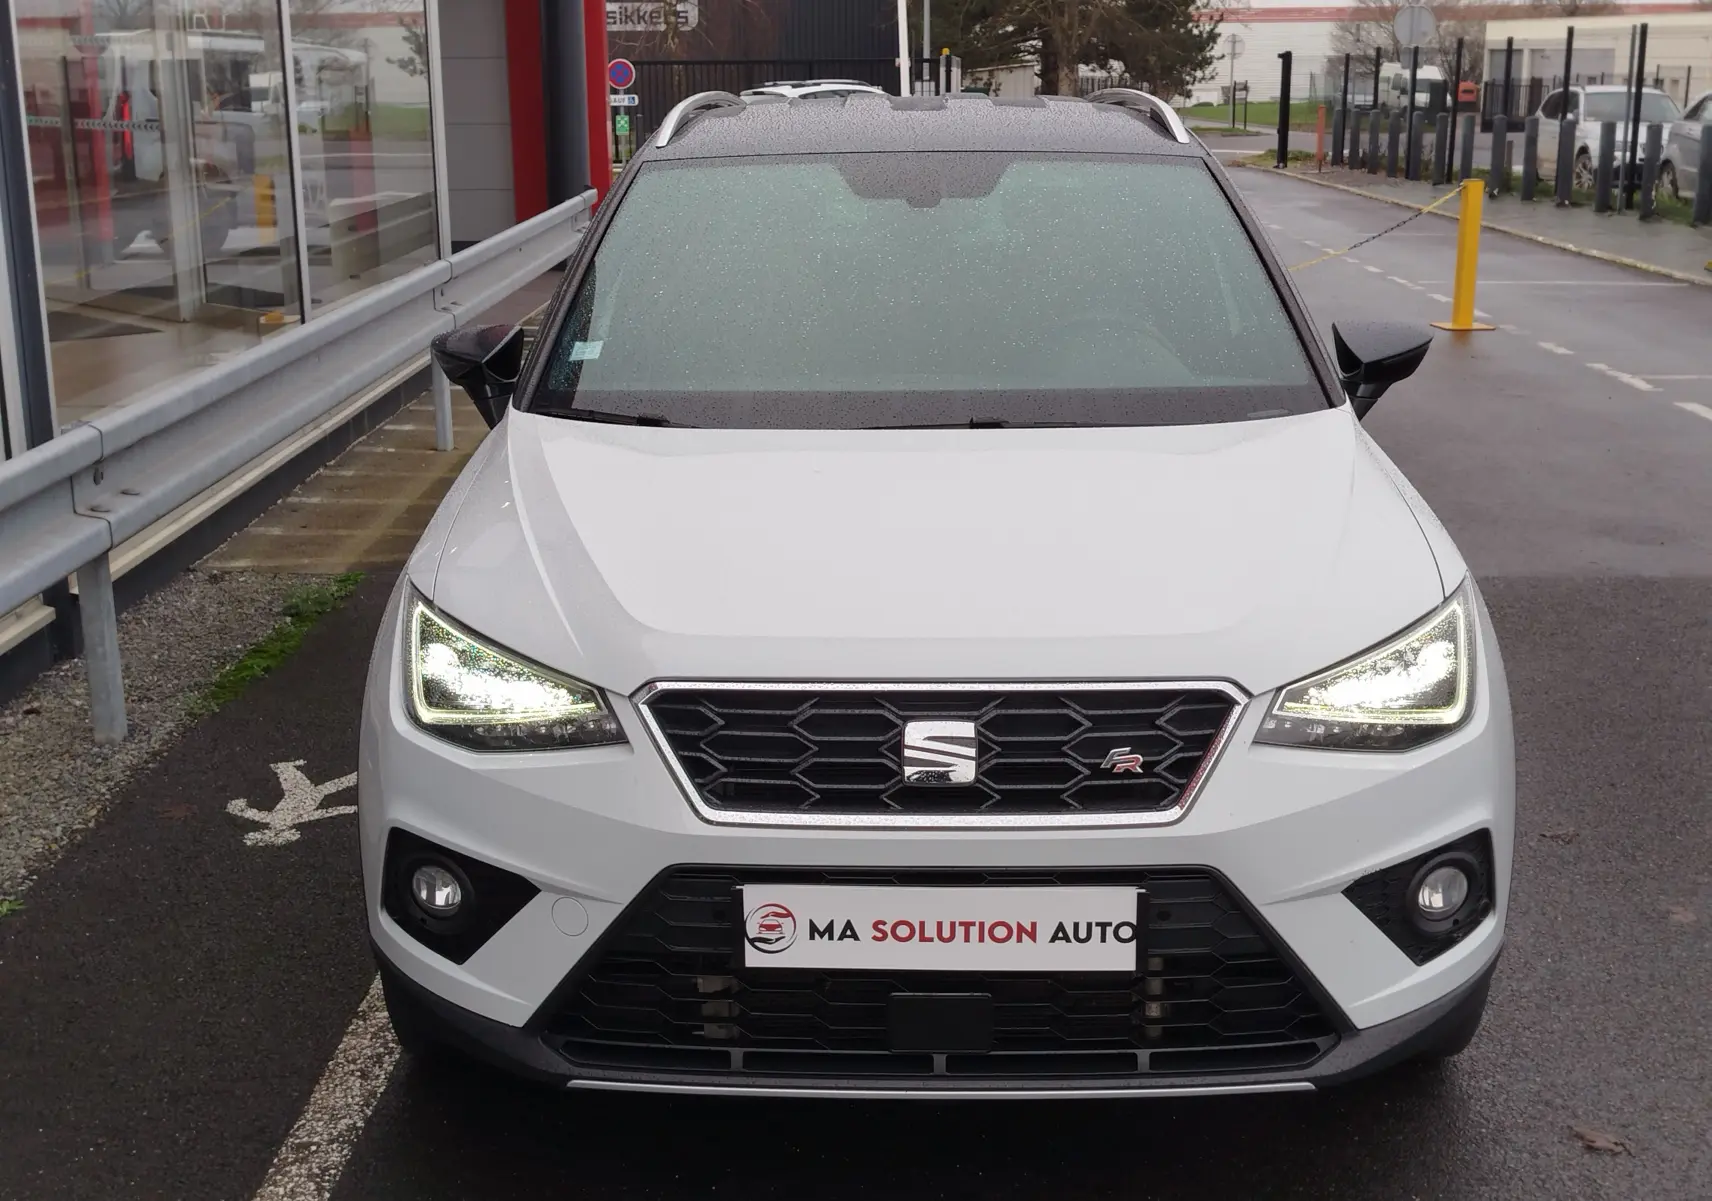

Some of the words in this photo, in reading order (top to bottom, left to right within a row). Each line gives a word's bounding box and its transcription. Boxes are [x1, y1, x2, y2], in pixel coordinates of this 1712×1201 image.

[606, 6, 689, 25] sikkes
[1099, 746, 1144, 773] FR
[808, 918, 861, 942] MA
[871, 919, 1037, 944] SOLUTION
[1048, 920, 1138, 945] AUTO
